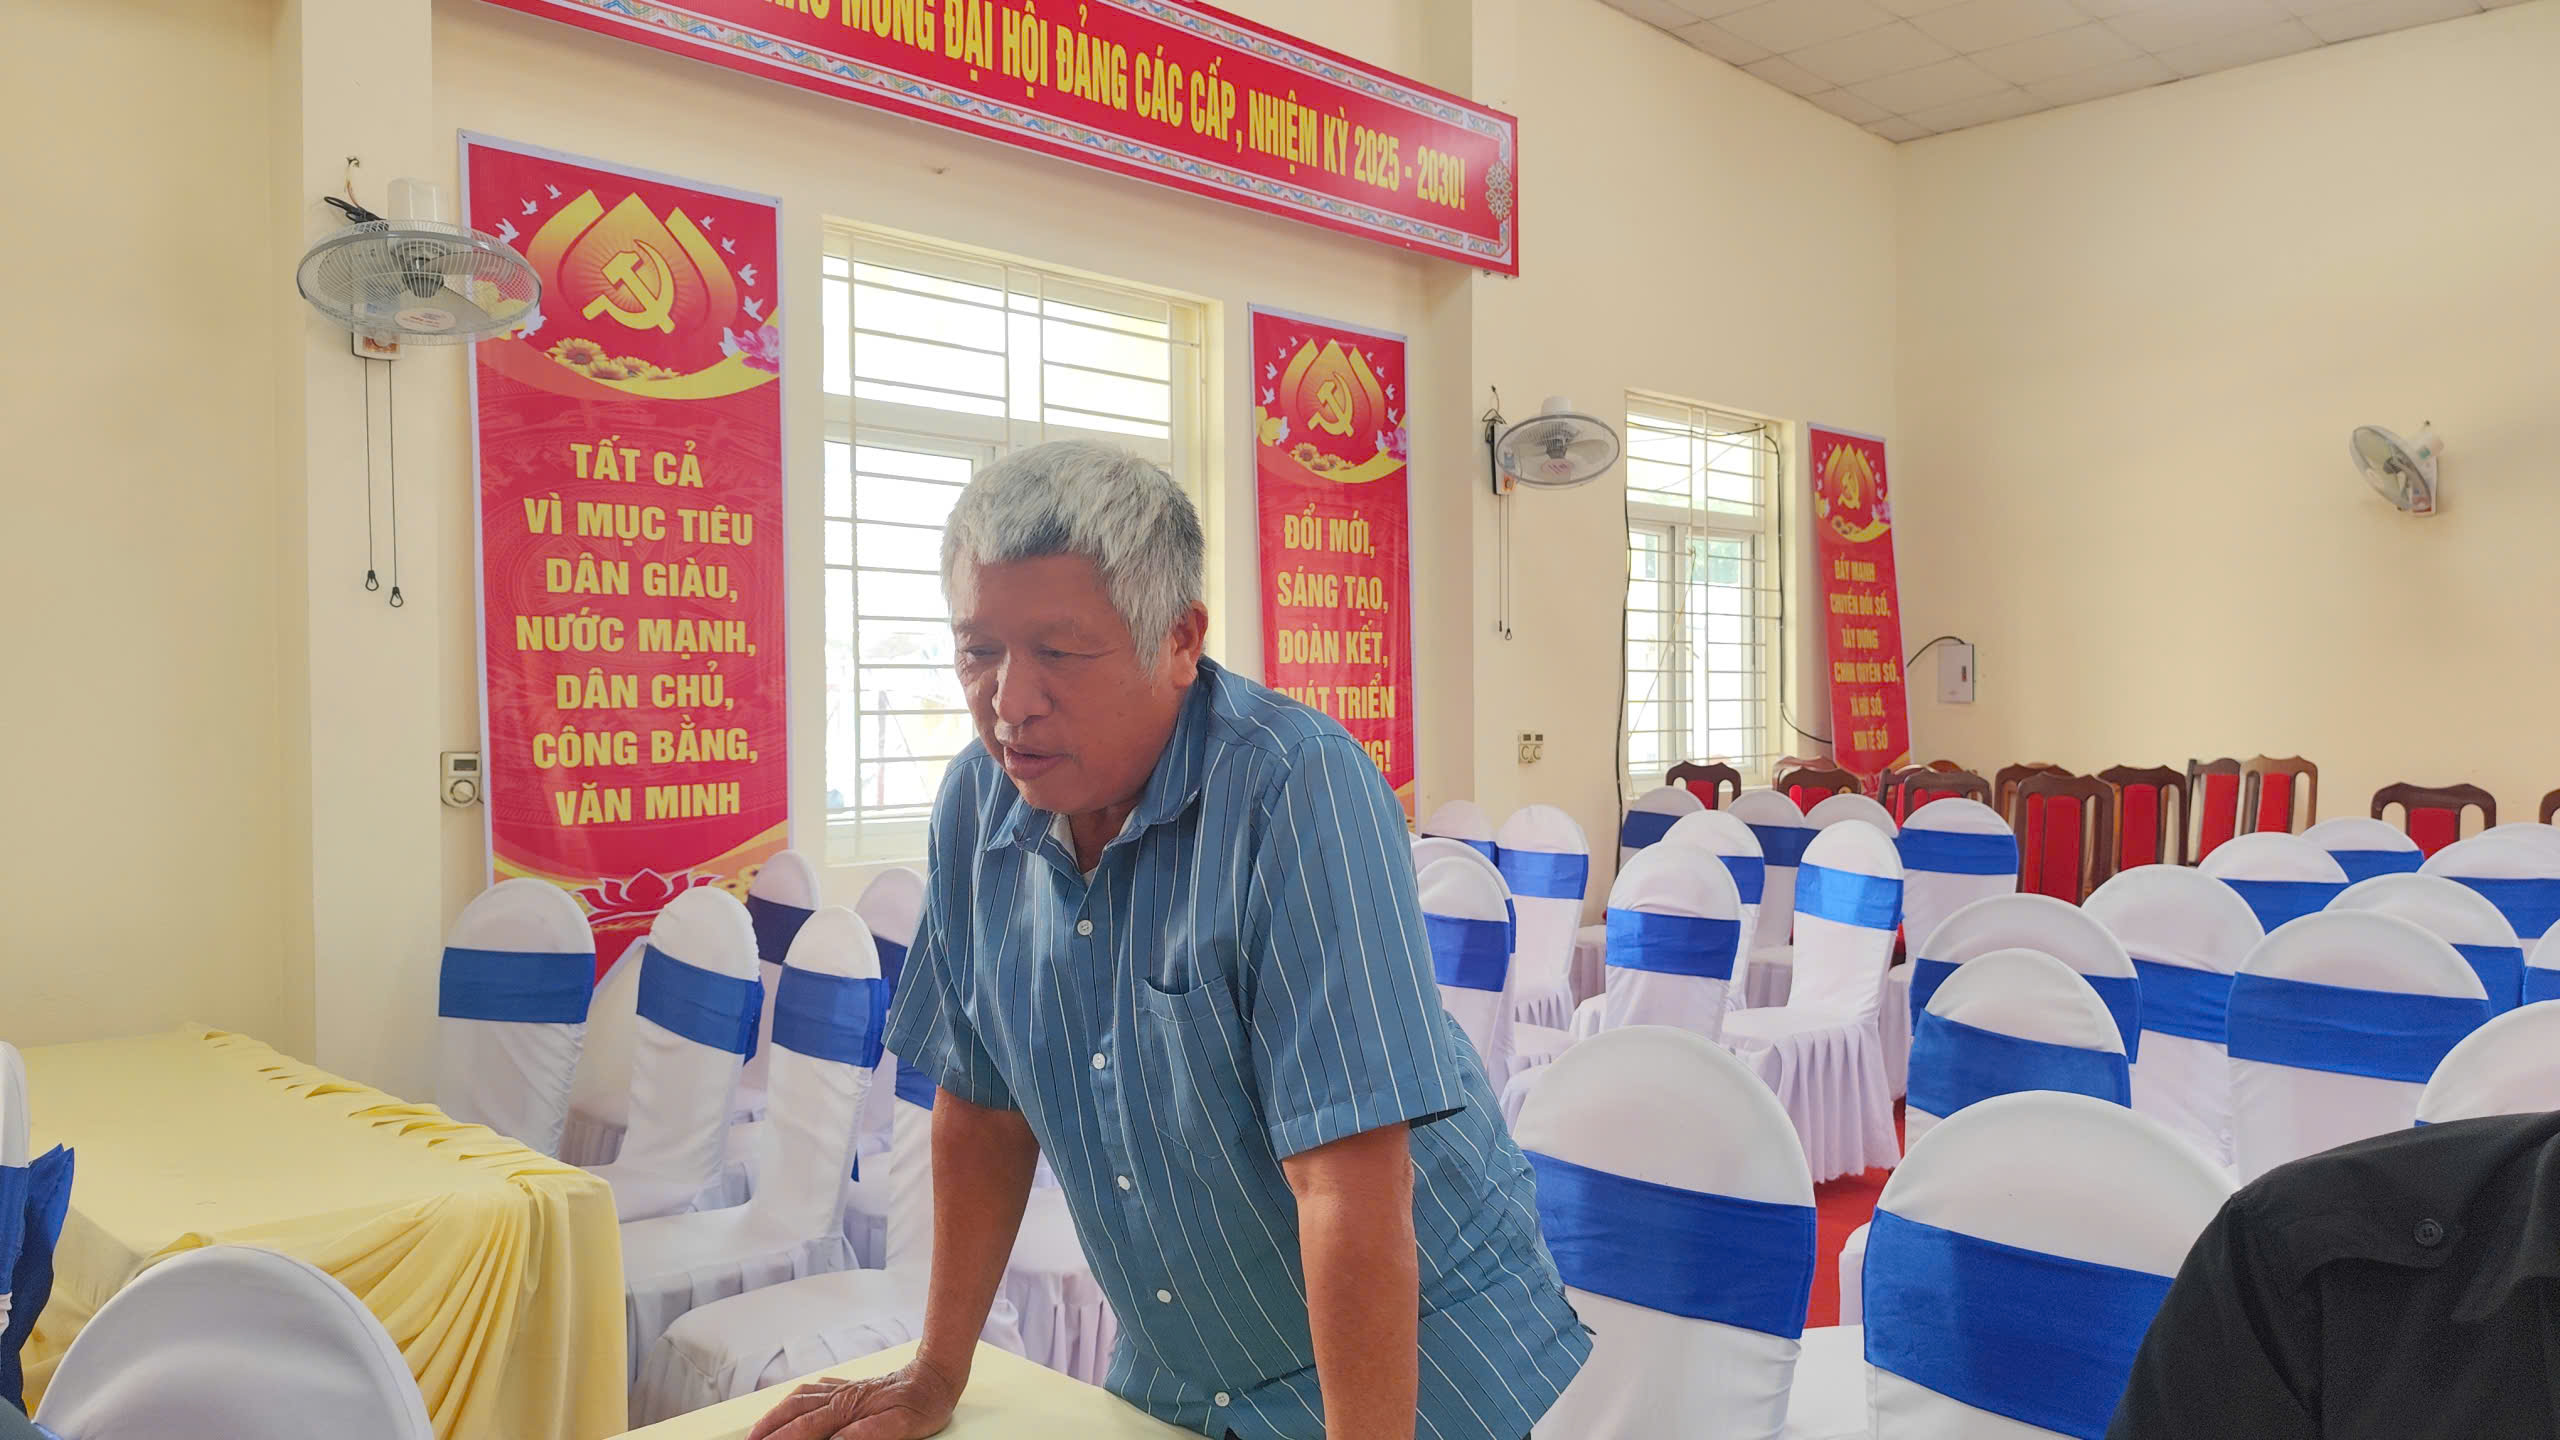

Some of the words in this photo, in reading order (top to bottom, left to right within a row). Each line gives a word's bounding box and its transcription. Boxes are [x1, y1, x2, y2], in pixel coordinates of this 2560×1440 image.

[944, 0, 992, 82] ĐẠI
[1002, 0, 1048, 99] HỘI
[1056, 3, 1128, 111] ĐẢNG
[1135, 44, 1184, 128] CÁC
[1248, 89, 1318, 175] NHIỆM
[1324, 106, 1349, 176] KỲ
[1354, 125, 1400, 192] 2025
[1405, 165, 1413, 179] -
[1417, 145, 1466, 211] 2030!
[570, 435, 641, 483] TẤT
[653, 439, 704, 488] CẢ
[523, 492, 562, 535] VÌ
[576, 501, 666, 547] MỤC
[677, 504, 753, 546] TIÊU
[1284, 503, 1322, 551] ĐỔI
[1329, 510, 1375, 559] MỚI,
[546, 552, 630, 595] DÂN
[643, 557, 738, 603] GIÀU,
[1277, 565, 1338, 609] SÁNG
[1344, 576, 1389, 617] TẠO,
[515, 606, 624, 652] NƯỚC
[638, 617, 756, 660] MẠNH,
[1278, 622, 1340, 665] ĐOÀN
[1346, 620, 1388, 668] KẾT,
[556, 667, 638, 710] DÂN
[651, 660, 734, 711] CHỦ,
[1273, 679, 1330, 714] ÁT
[1336, 672, 1395, 720] TRIỂN
[532, 725, 638, 769] CÔNG
[651, 714, 758, 764] BẰNG,
[555, 781, 631, 826] VĂN
[645, 782, 740, 820] MINH
